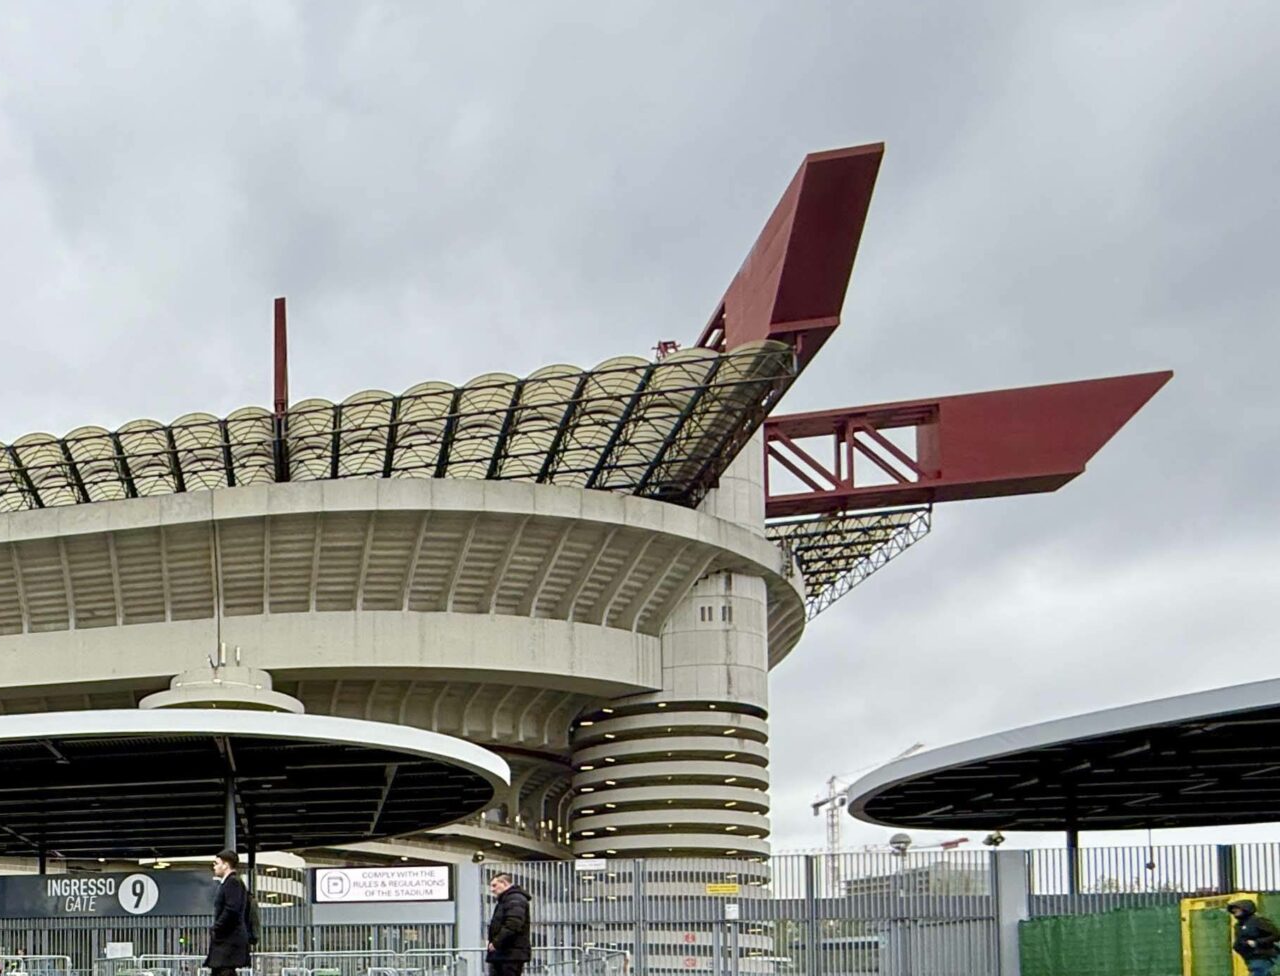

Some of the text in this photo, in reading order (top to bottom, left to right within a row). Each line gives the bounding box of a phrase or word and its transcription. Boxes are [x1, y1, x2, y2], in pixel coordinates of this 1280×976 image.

[361, 871, 395, 879] COMPLY
[47, 878, 115, 896] INGRESSO
[353, 879, 446, 888] RULES & REGULATIONS
[131, 879, 145, 909] 9
[377, 889, 392, 897] THE
[394, 888, 434, 897] STADIUM
[65, 895, 98, 912] GATE
